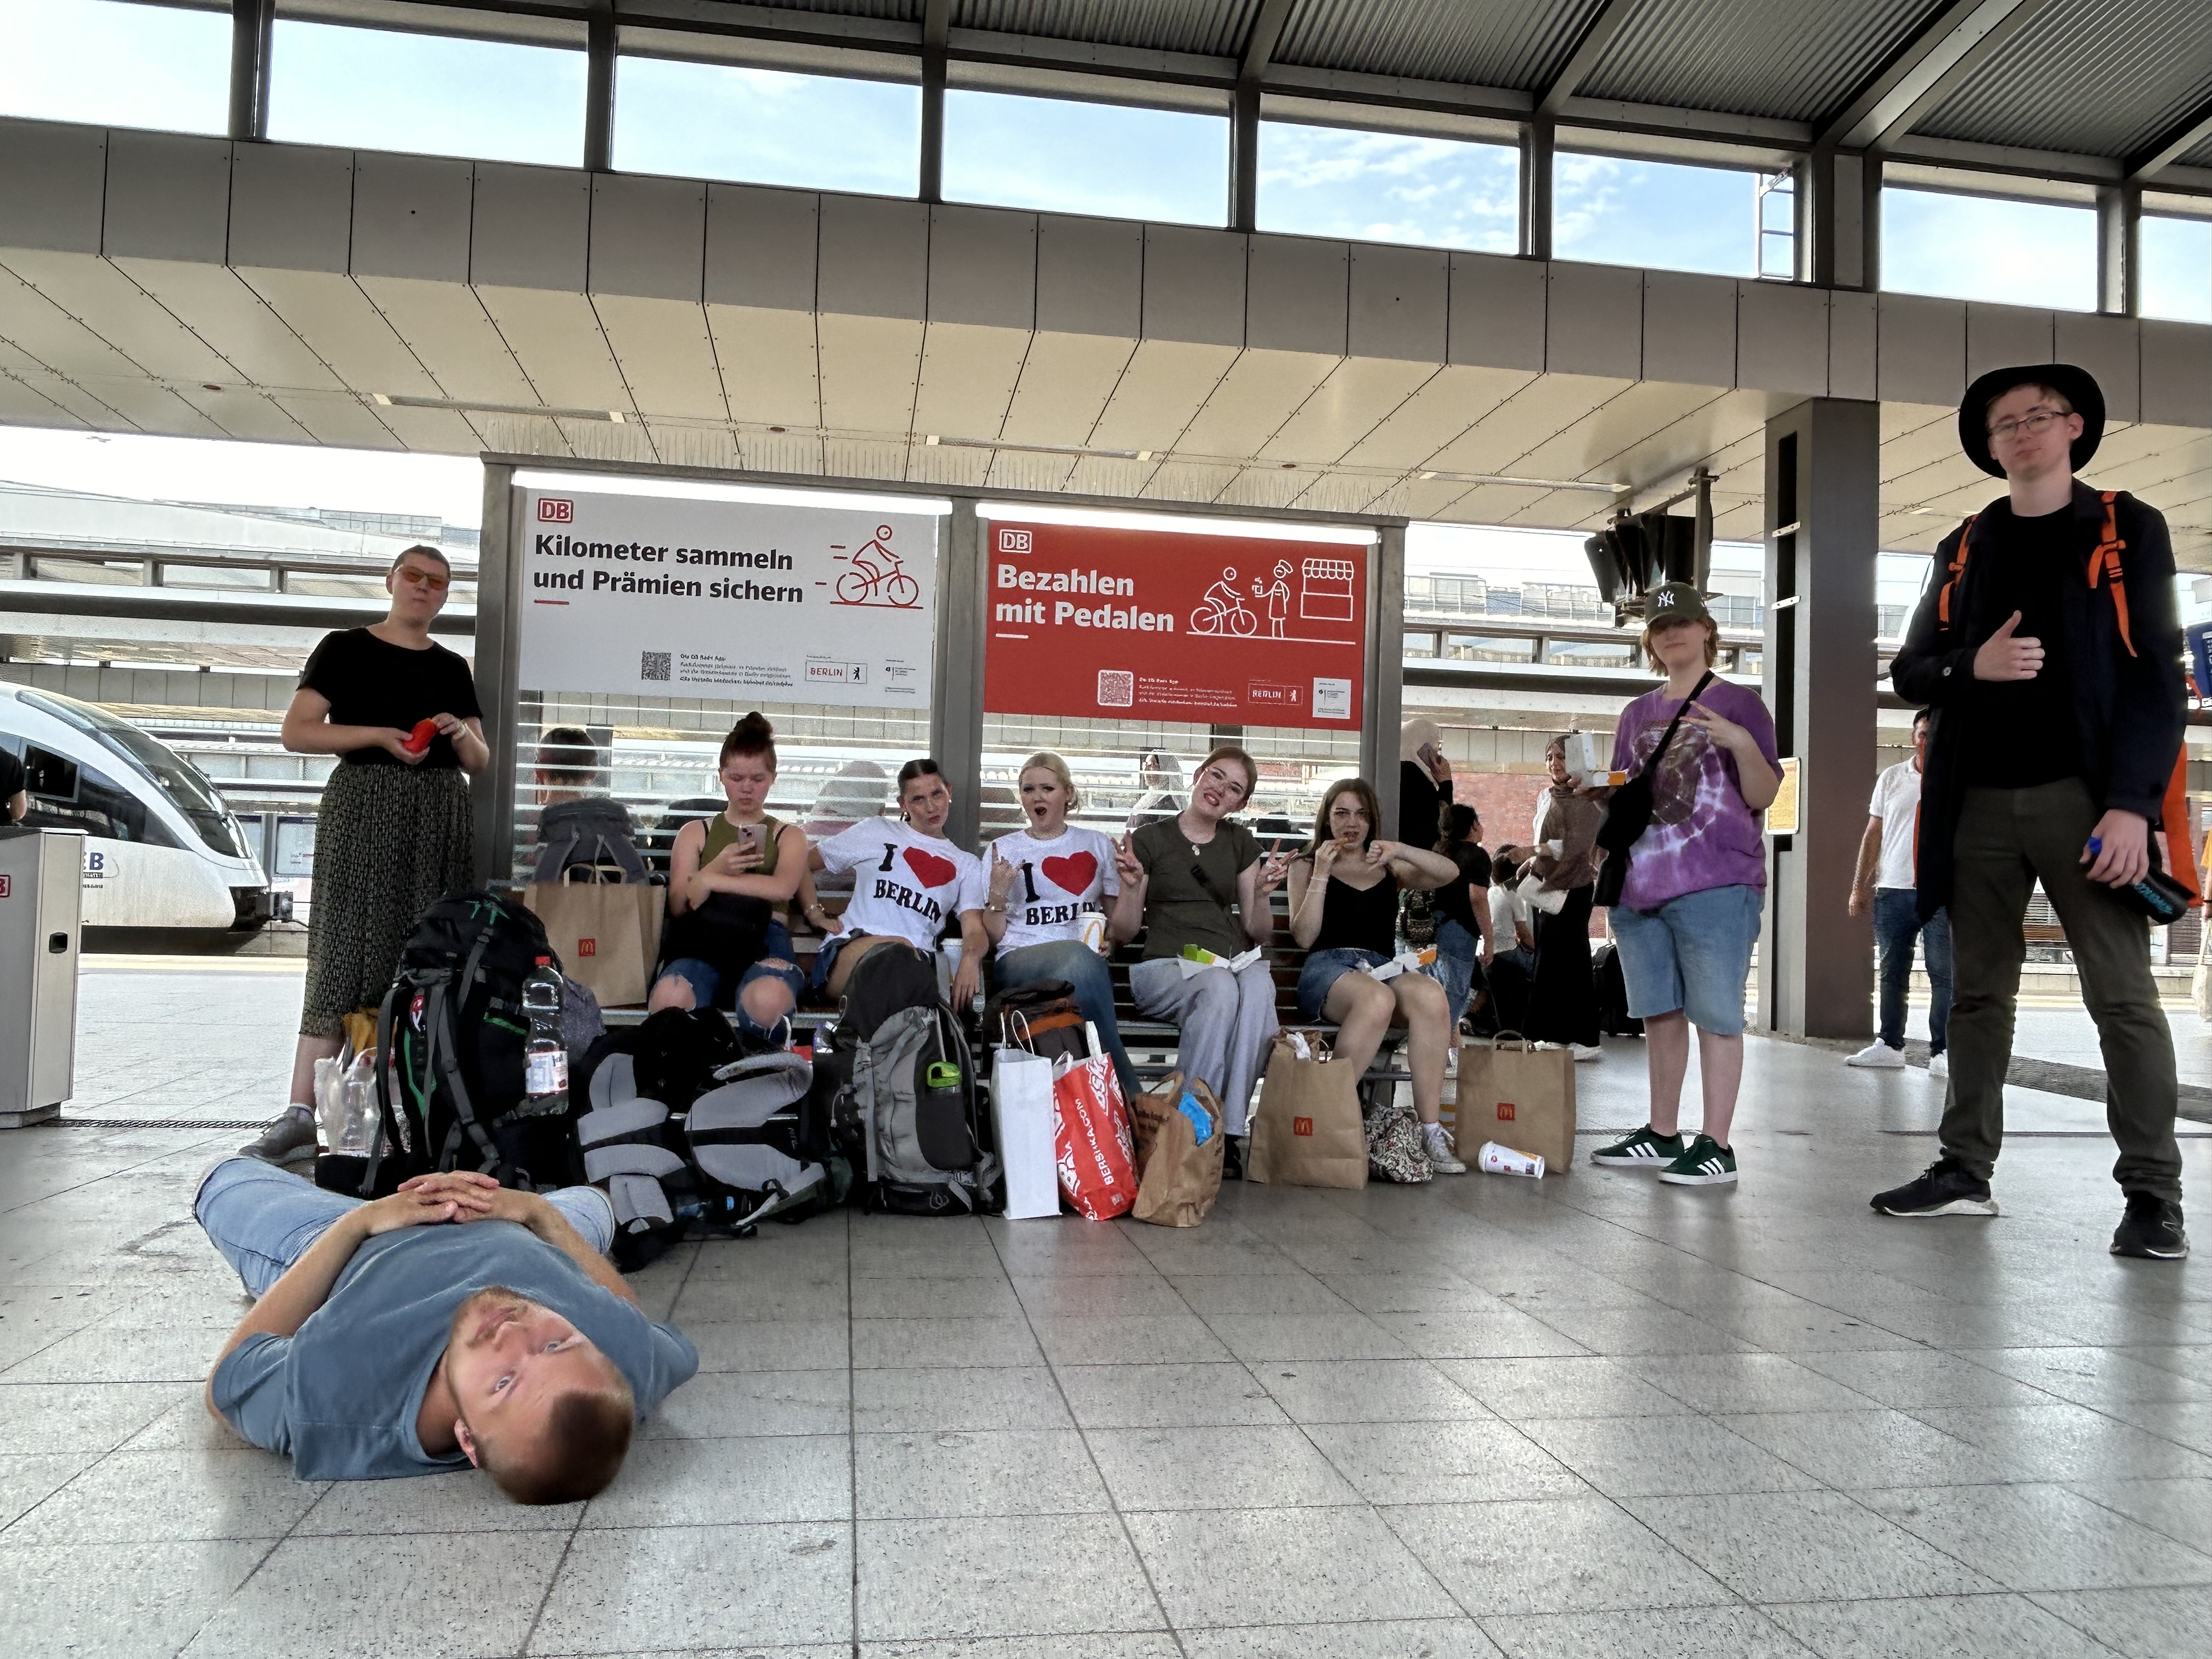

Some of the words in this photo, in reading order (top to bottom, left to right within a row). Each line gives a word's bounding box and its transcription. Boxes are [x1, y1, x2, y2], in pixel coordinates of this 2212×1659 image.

[541, 500, 570, 520] DB
[535, 534, 669, 562] Kilometer
[675, 548, 793, 571] sammeln
[1002, 532, 1029, 550] DB
[534, 569, 584, 590] und
[592, 570, 702, 597] Prämien
[709, 577, 803, 603] sichern
[997, 563, 1134, 596] Bezahlen
[996, 597, 1046, 624] mit
[1054, 601, 1174, 632] Pedalen
[810, 667, 843, 676] BERLIN
[878, 843, 898, 871] I
[1022, 862, 1041, 903] I
[873, 879, 942, 924] BERLIN
